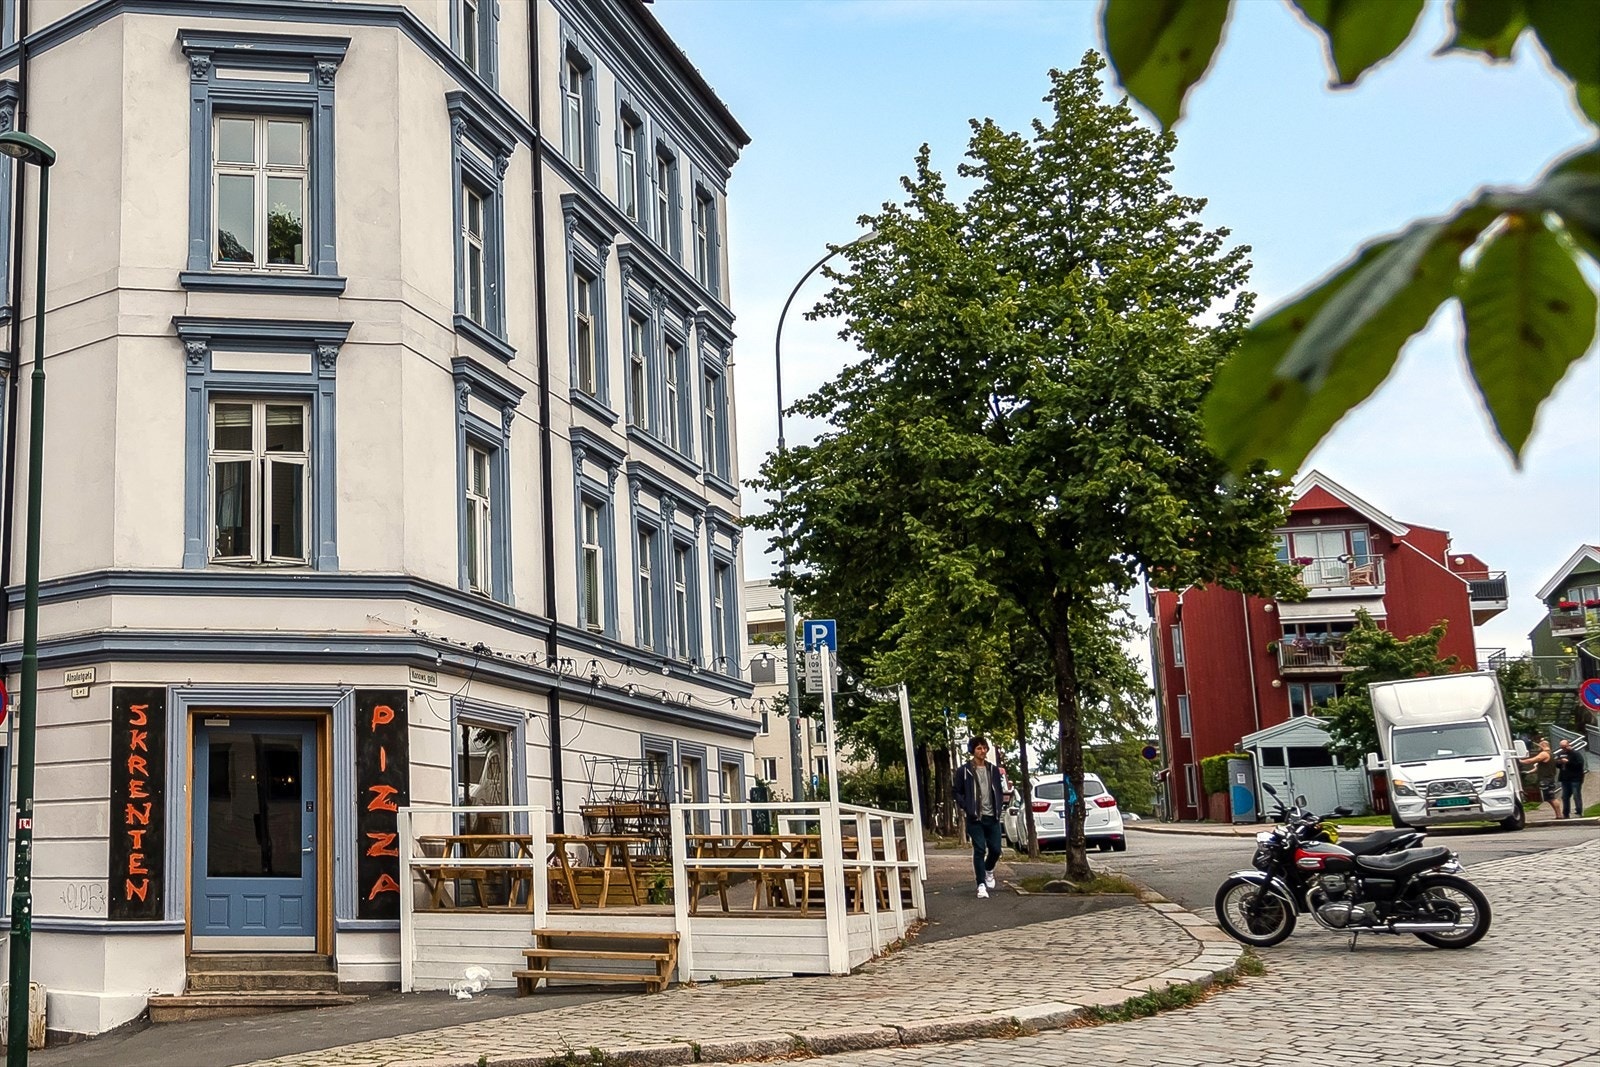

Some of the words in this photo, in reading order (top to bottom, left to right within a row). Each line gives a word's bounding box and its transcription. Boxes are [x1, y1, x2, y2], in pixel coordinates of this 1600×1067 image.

[811, 624, 828, 646] P
[125, 704, 152, 902] SKRENTEN
[366, 705, 400, 901] PIZZA
